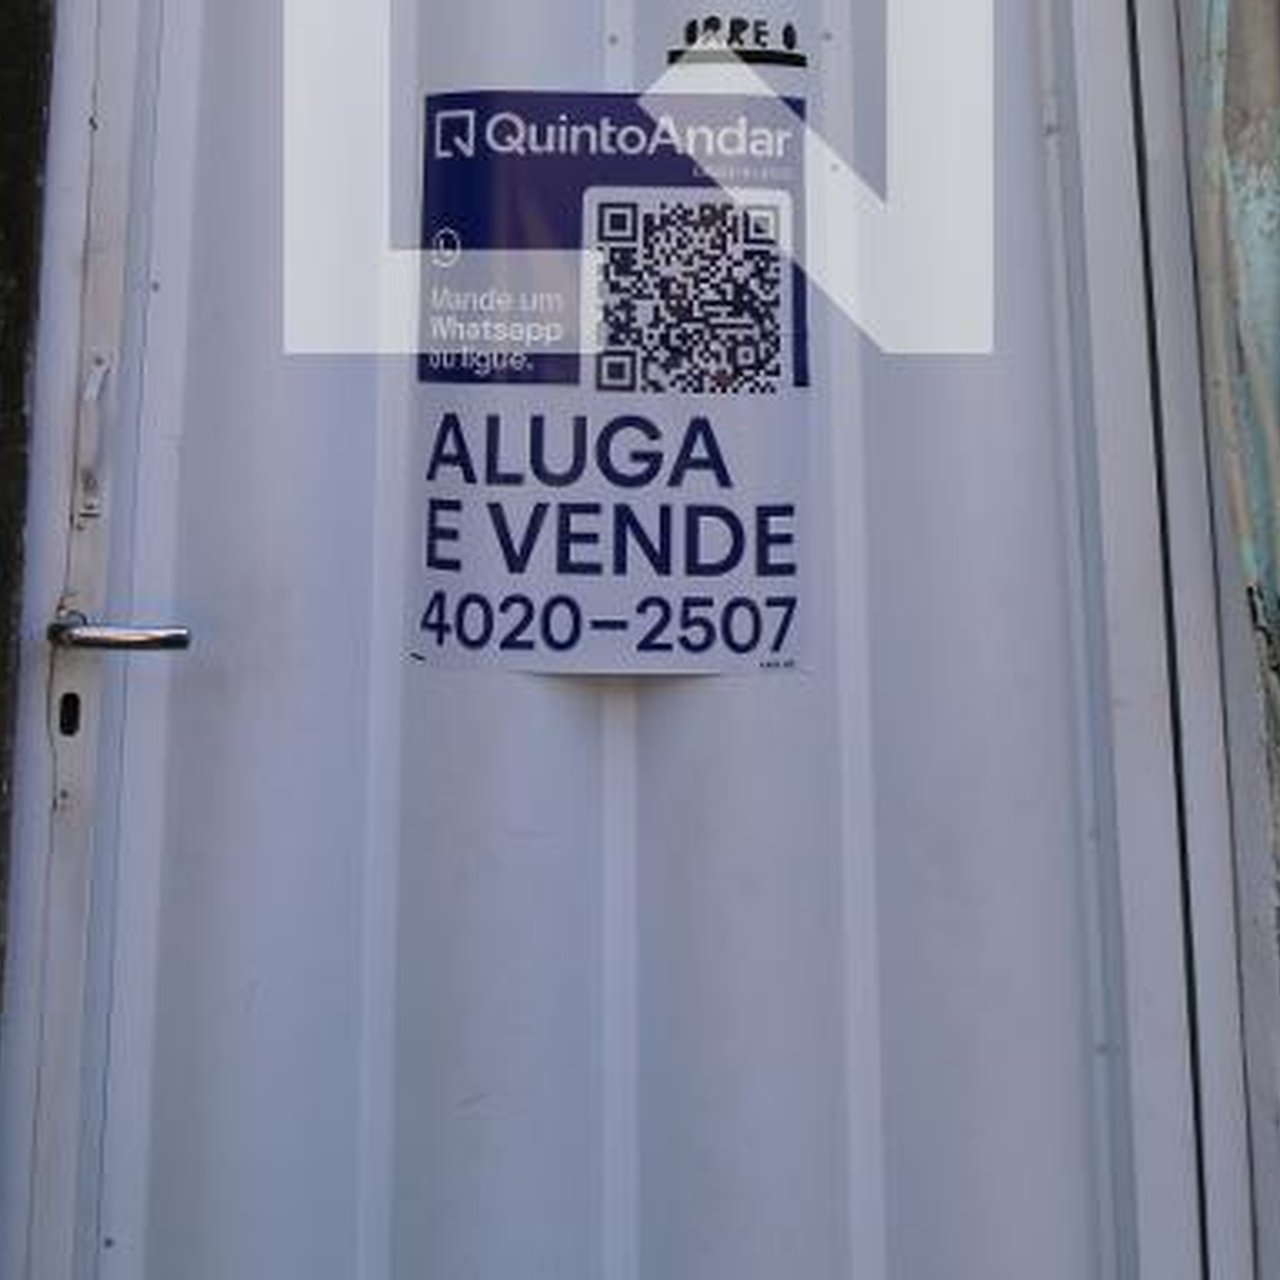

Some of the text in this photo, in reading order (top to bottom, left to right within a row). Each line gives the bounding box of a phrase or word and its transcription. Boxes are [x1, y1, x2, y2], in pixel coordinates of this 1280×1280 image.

[485, 112, 793, 159] QuintoAndar
[520, 291, 565, 314] um
[430, 315, 565, 348] Whatsapp
[425, 413, 733, 488] ALUGA
[425, 498, 798, 578] E VENDE
[421, 591, 798, 654] 4020-2507
